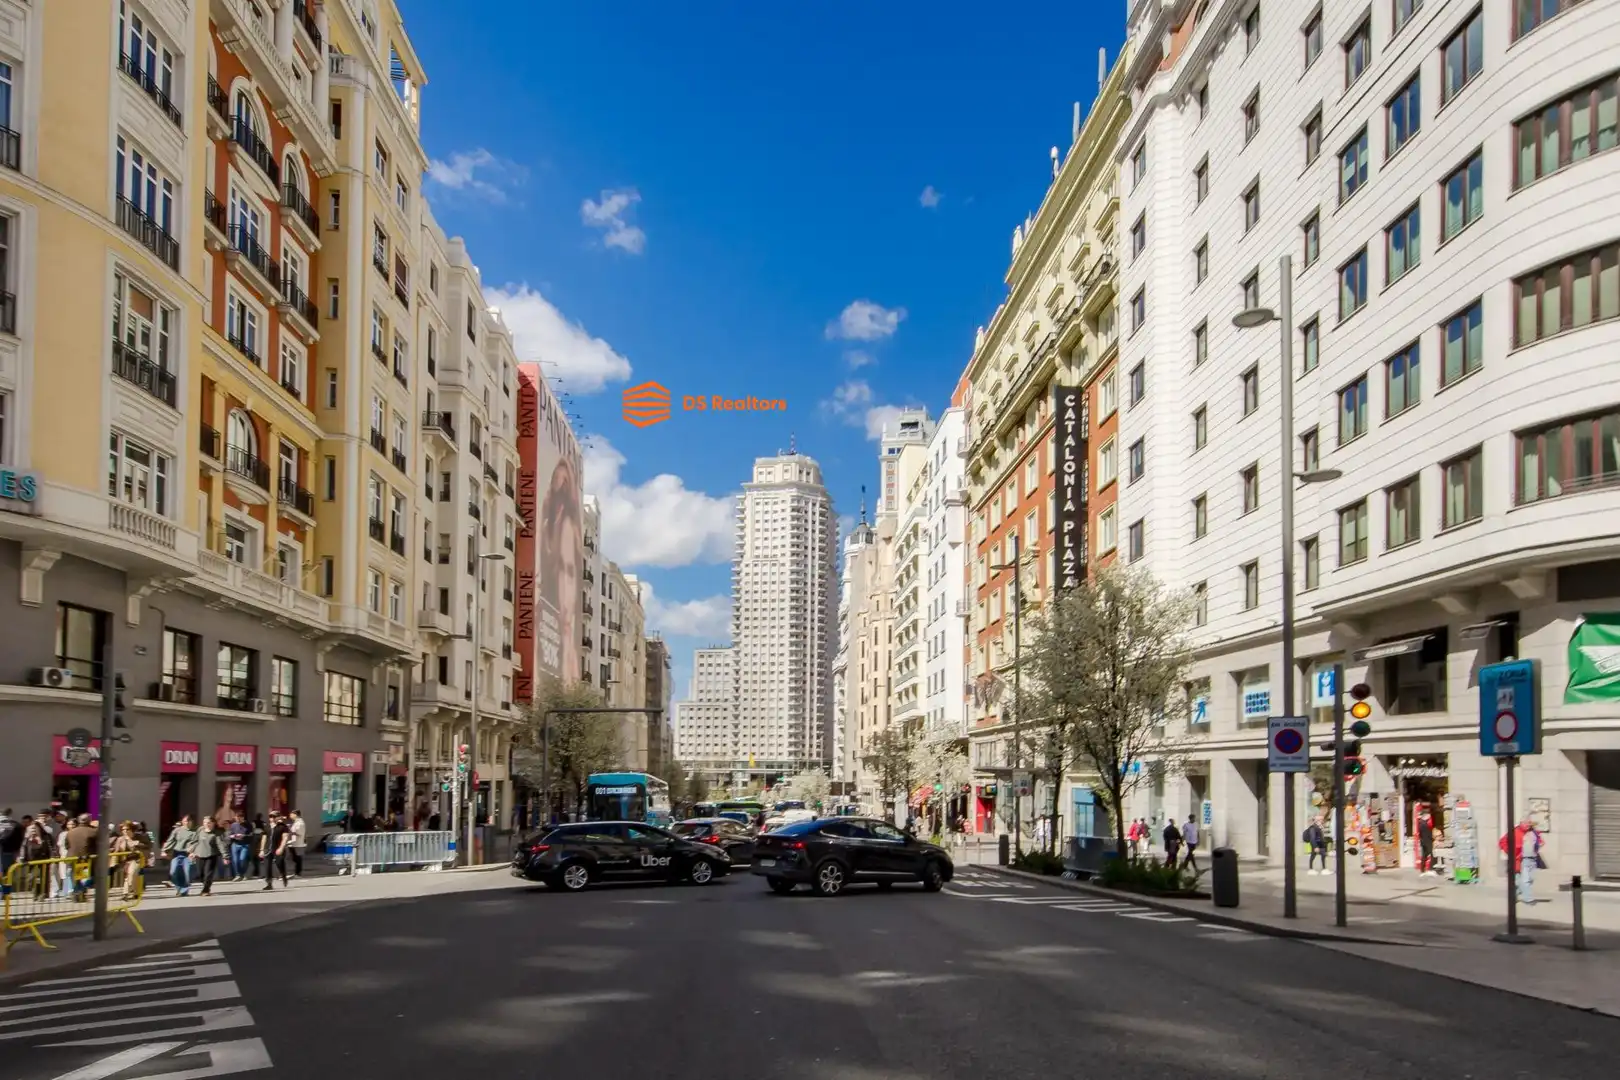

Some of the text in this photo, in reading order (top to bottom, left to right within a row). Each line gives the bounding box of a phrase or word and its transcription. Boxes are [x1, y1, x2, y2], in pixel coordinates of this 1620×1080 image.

[520, 470, 535, 538] PANTENE
[1063, 394, 1076, 588] CATALONIA PLAZA
[519, 569, 533, 640] PANTENE
[641, 854, 672, 867] Uber
